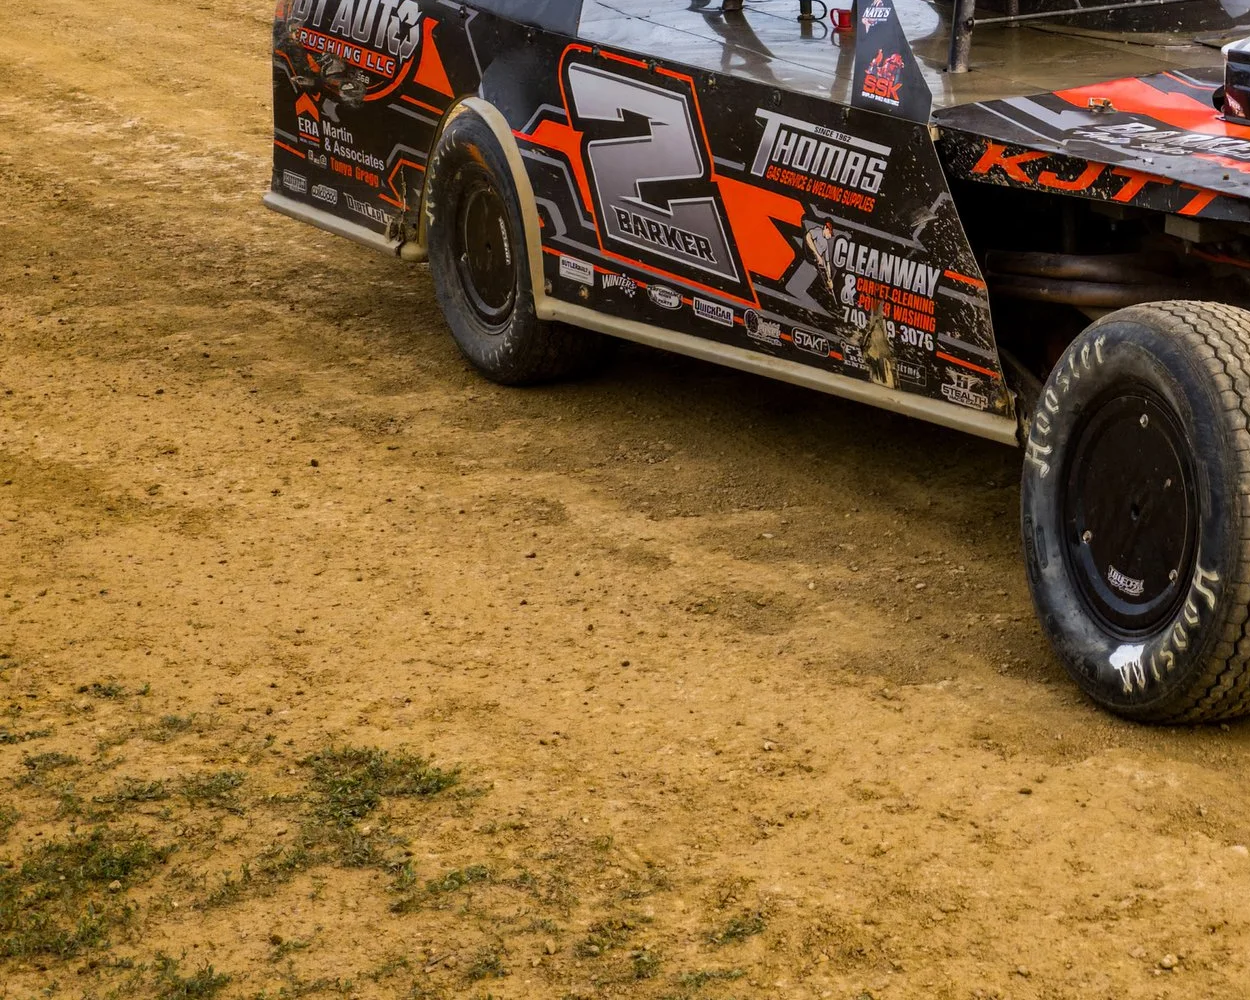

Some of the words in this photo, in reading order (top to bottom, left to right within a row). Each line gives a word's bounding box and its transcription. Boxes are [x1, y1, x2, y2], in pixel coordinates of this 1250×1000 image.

[862, 6, 892, 18] NATE'S
[366, 53, 395, 75] LLC
[863, 73, 902, 101] SSK
[298, 117, 320, 137] ERA
[322, 120, 354, 144] Martin
[814, 126, 834, 138] SINCE
[835, 131, 852, 143] 1962
[325, 137, 332, 152] &
[333, 140, 385, 171] Associates
[750, 107, 892, 194] THOMAS
[330, 156, 353, 177] Tonya
[355, 166, 379, 188] Gragg
[568, 62, 741, 283] 2
[766, 164, 782, 182] GAS
[781, 170, 808, 192] SERVICE
[812, 180, 843, 202] WELDING
[842, 189, 876, 213] SUPPLIES
[610, 204, 718, 264] BARKER
[602, 274, 637, 289] WINTERS
[833, 238, 941, 298] CLEANWAY
[840, 273, 857, 306] &
[891, 288, 935, 315] CLEANING
[893, 305, 936, 334] WASHING
[942, 384, 988, 406] STEALTH
[1025, 334, 1107, 479] Hoosier
